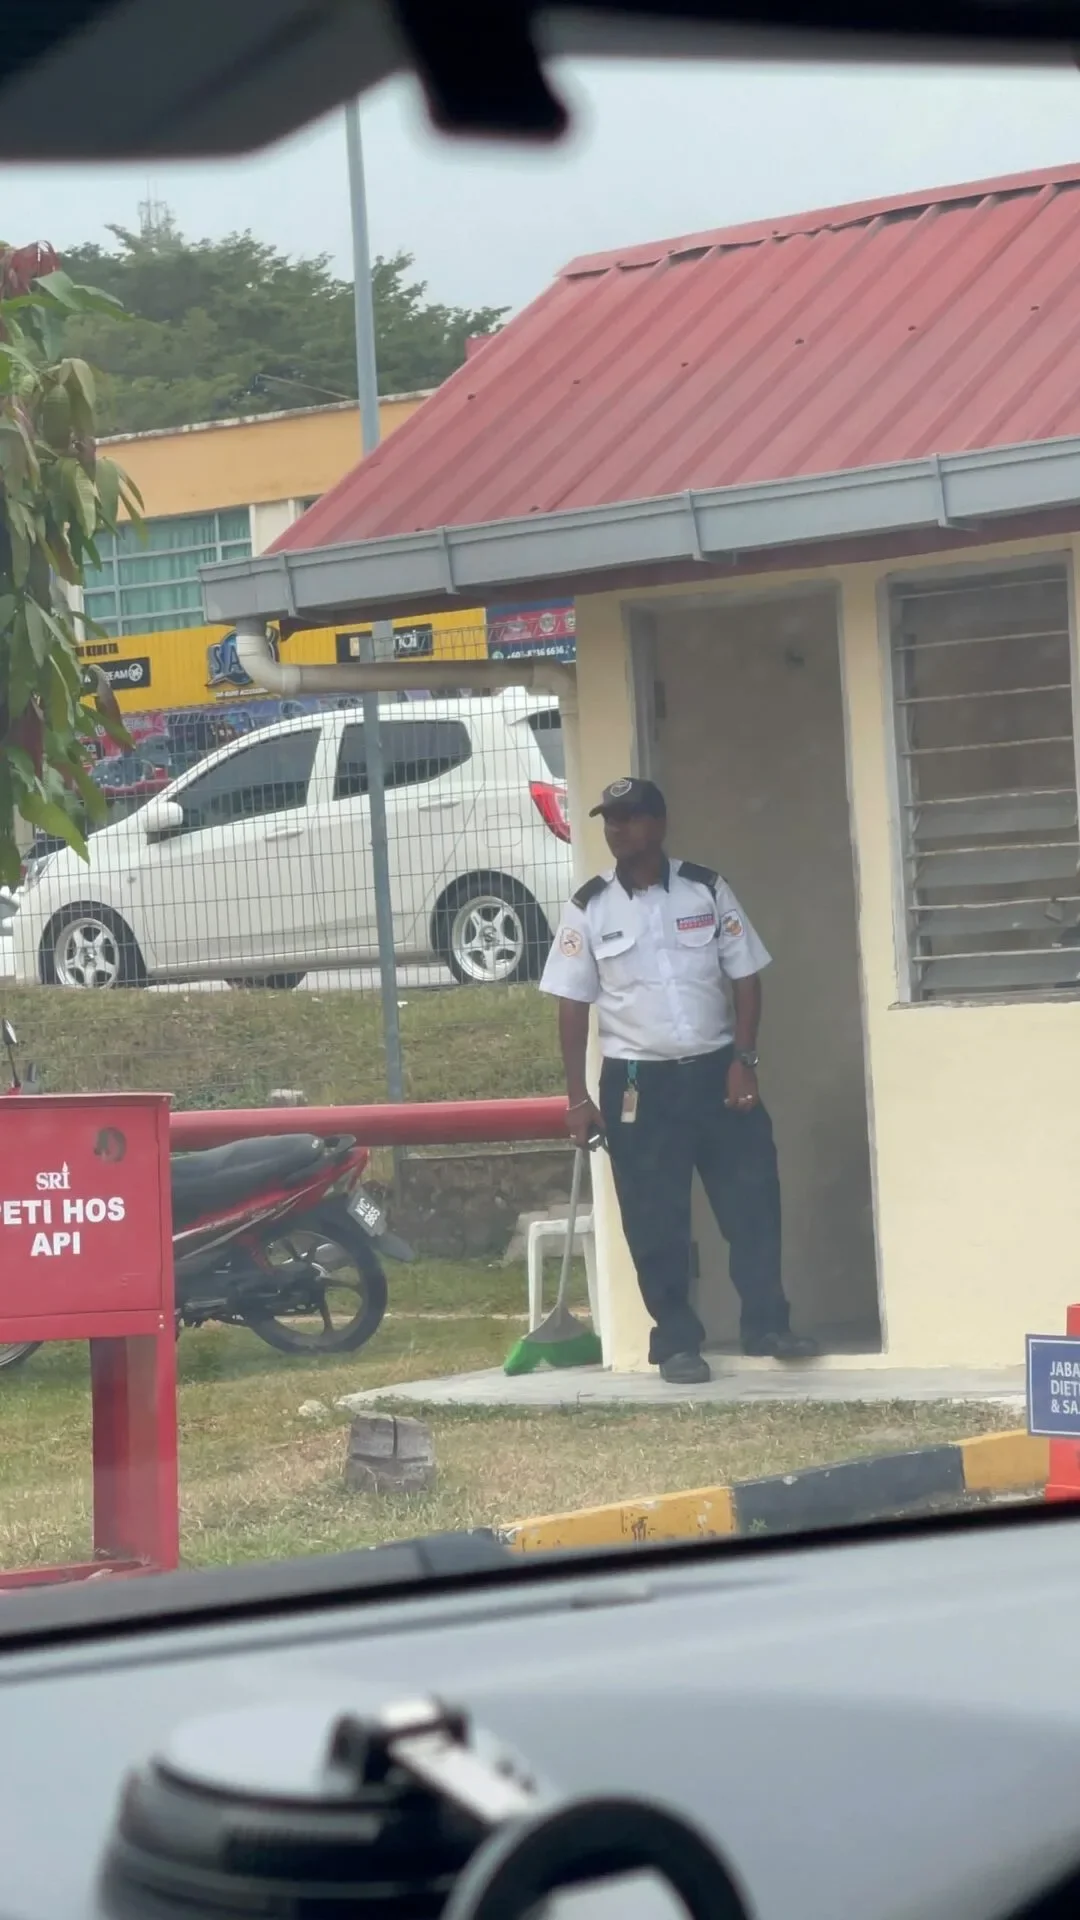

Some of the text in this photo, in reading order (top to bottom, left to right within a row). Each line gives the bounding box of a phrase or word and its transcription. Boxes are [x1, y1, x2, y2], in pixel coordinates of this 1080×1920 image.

[36, 1161, 71, 1190] SRI
[0, 1197, 125, 1225] ETI HOS
[30, 1231, 81, 1257] API
[1050, 1361, 1080, 1378] JABA
[1051, 1380, 1080, 1397] DIET
[1051, 1399, 1080, 1415] & SA
